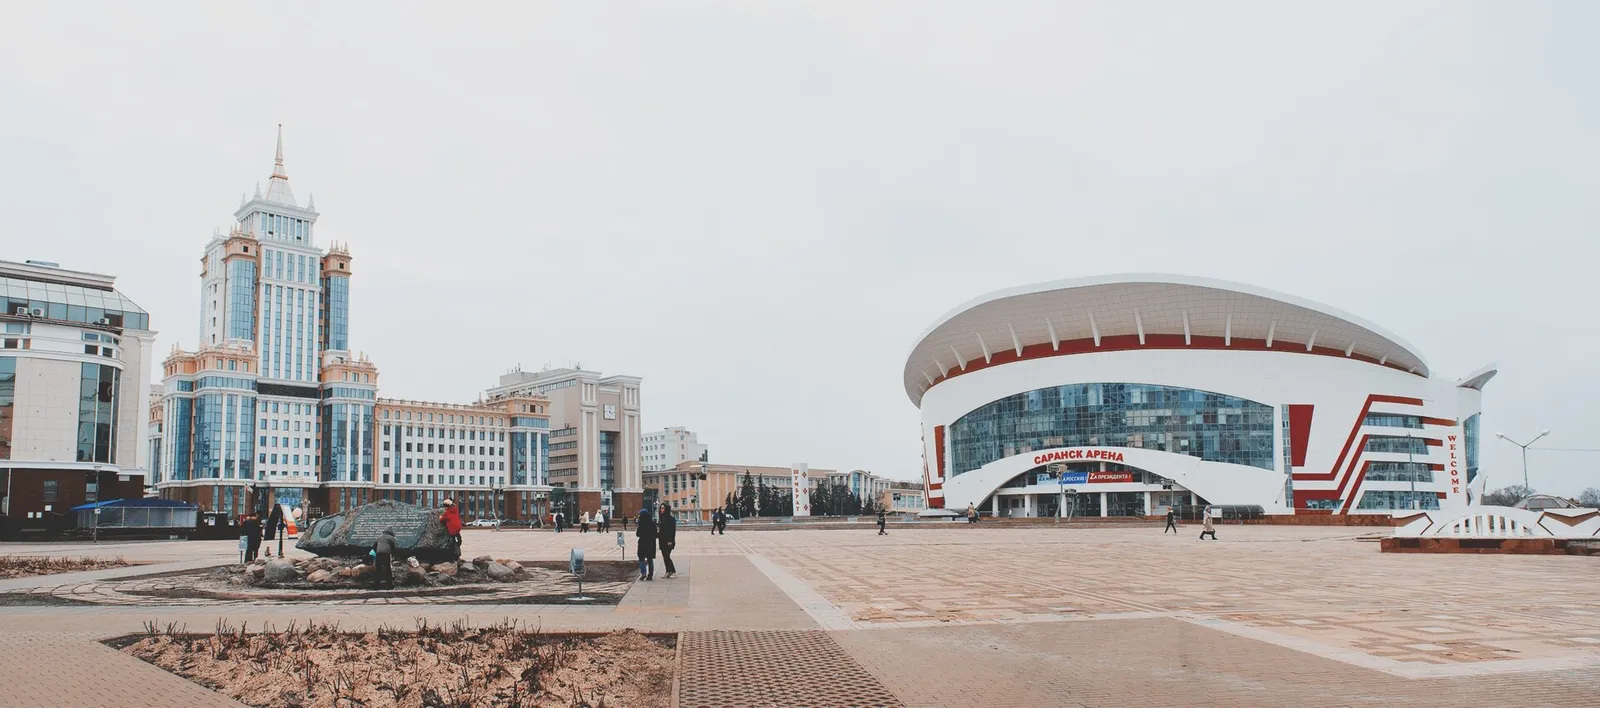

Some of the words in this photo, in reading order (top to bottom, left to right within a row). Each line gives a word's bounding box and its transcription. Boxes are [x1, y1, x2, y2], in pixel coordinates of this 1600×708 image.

[1034, 450, 1083, 464] САРАНСК
[1086, 449, 1124, 462] АРЕНА
[1447, 435, 1460, 494] WELCOME
